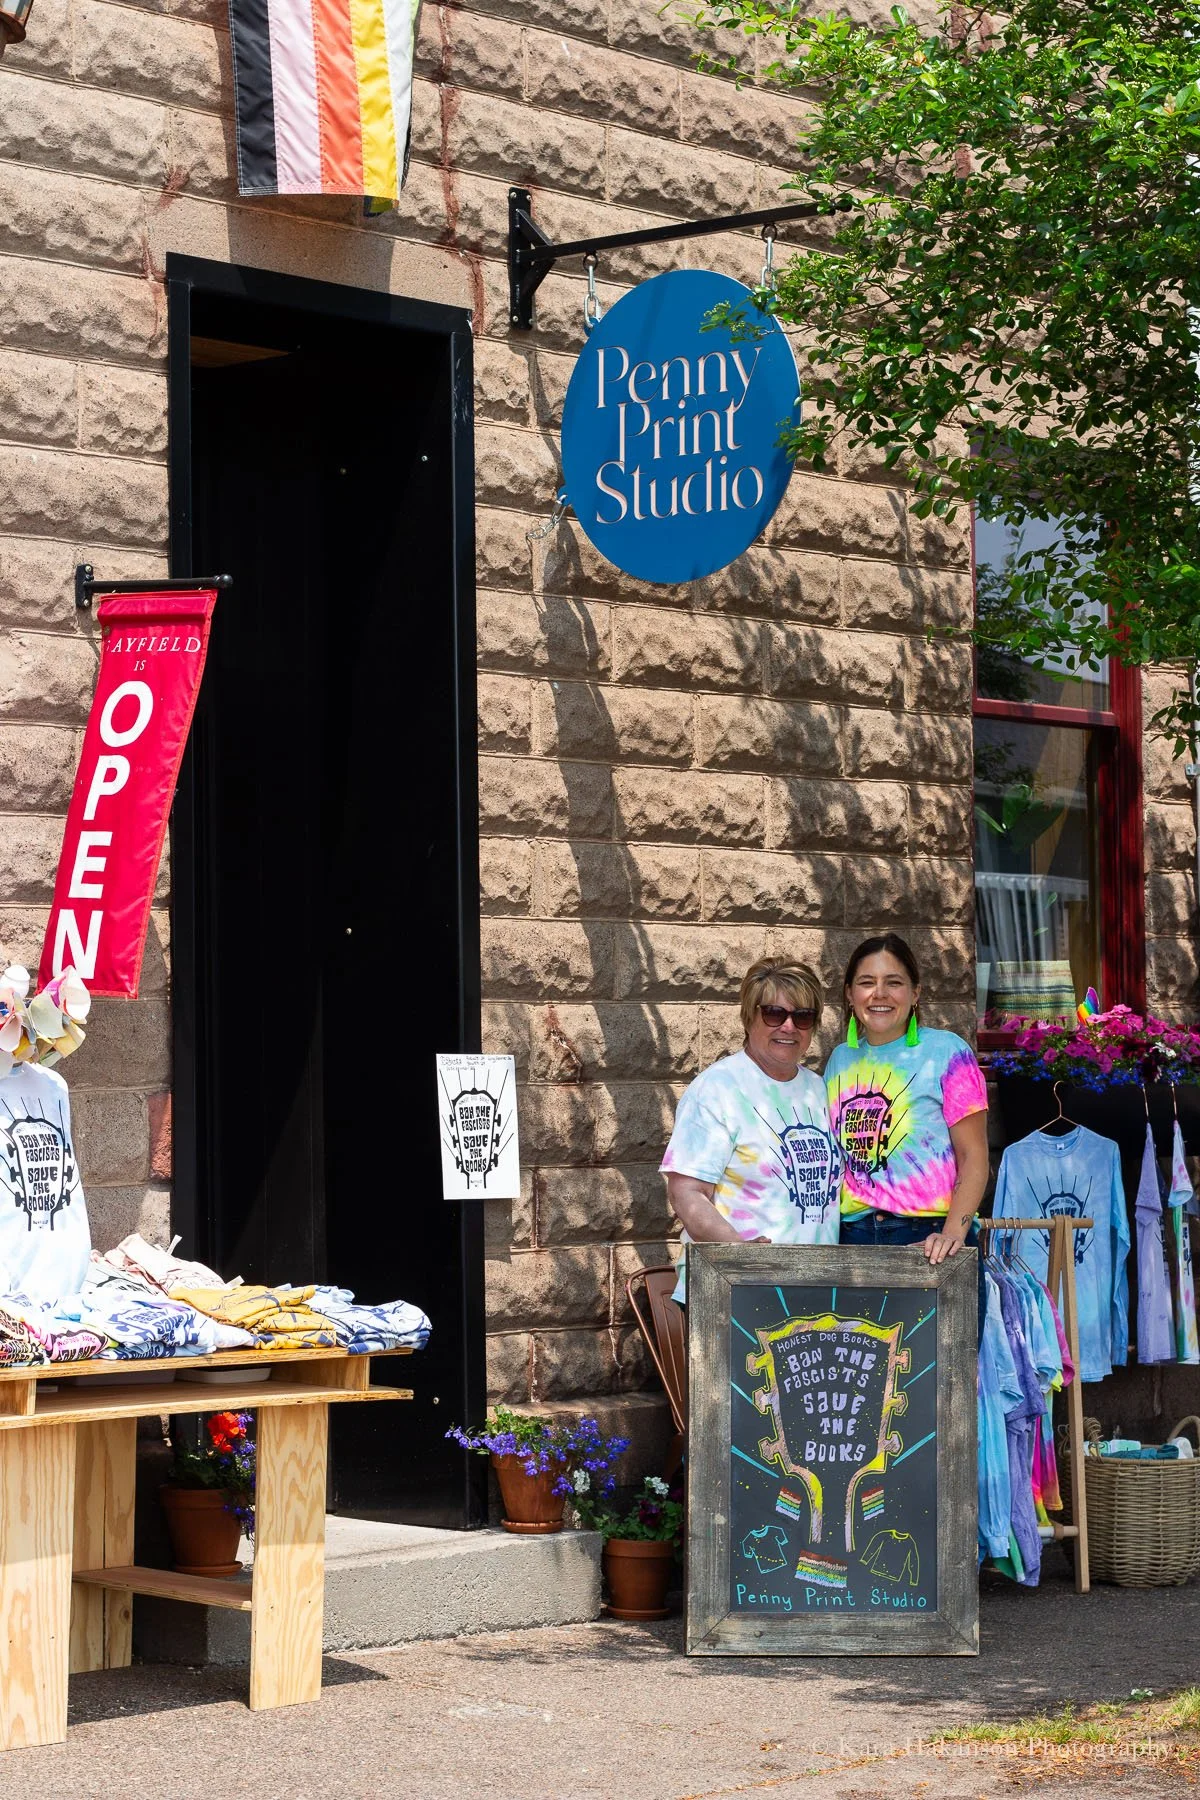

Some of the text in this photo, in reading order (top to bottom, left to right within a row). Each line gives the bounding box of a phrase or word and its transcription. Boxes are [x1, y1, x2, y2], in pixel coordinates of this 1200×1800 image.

[597, 346, 762, 413] Penny
[617, 395, 743, 474] Print
[596, 455, 763, 524] Studio
[106, 636, 202, 653] AYFIELD
[134, 660, 147, 671] IS
[52, 680, 154, 980] OPEN
[776, 1332, 878, 1353] HONEST DOG BOOKS
[834, 1346, 877, 1371] THE
[819, 1417, 857, 1436] THE
[804, 1440, 867, 1463] BOOKS
[736, 1583, 927, 1611] Penny Print Studio
